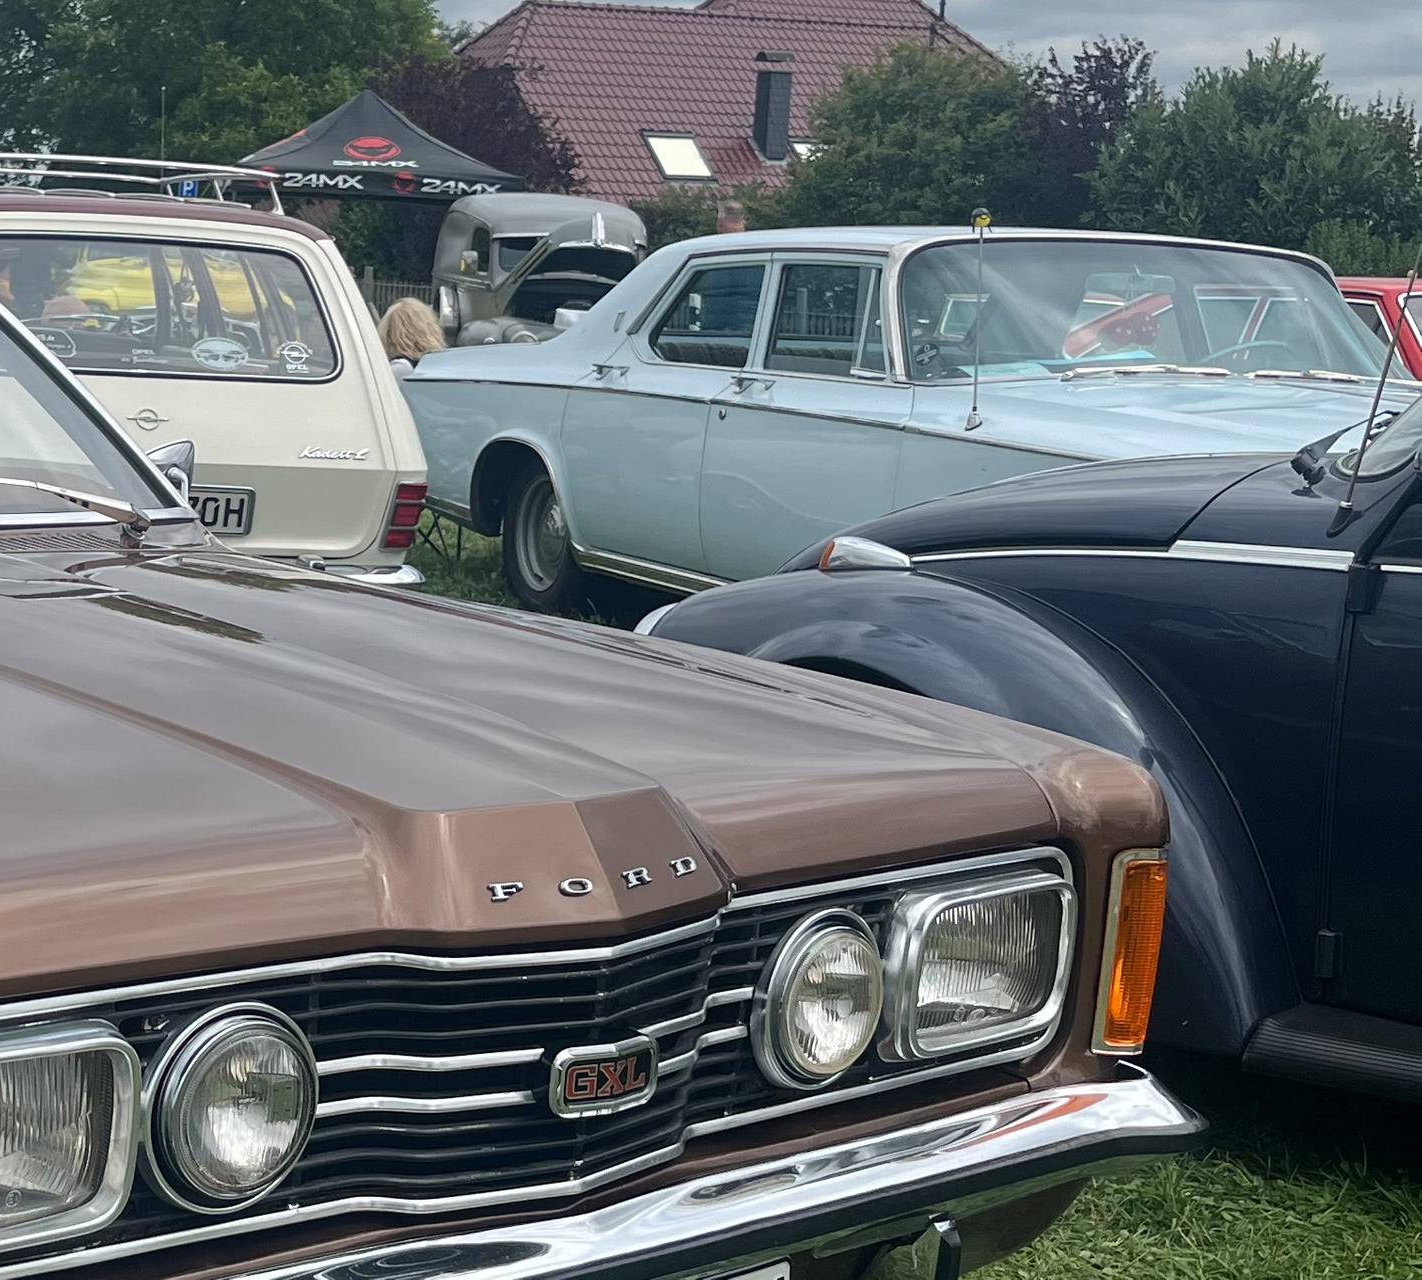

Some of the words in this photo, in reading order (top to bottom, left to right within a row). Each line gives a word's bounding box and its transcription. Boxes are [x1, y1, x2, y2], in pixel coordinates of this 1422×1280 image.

[182, 180, 195, 197] P
[282, 172, 365, 190] 24MX
[420, 178, 502, 195] 24MX
[487, 856, 698, 903] FORD
[565, 1056, 647, 1101] GXL
